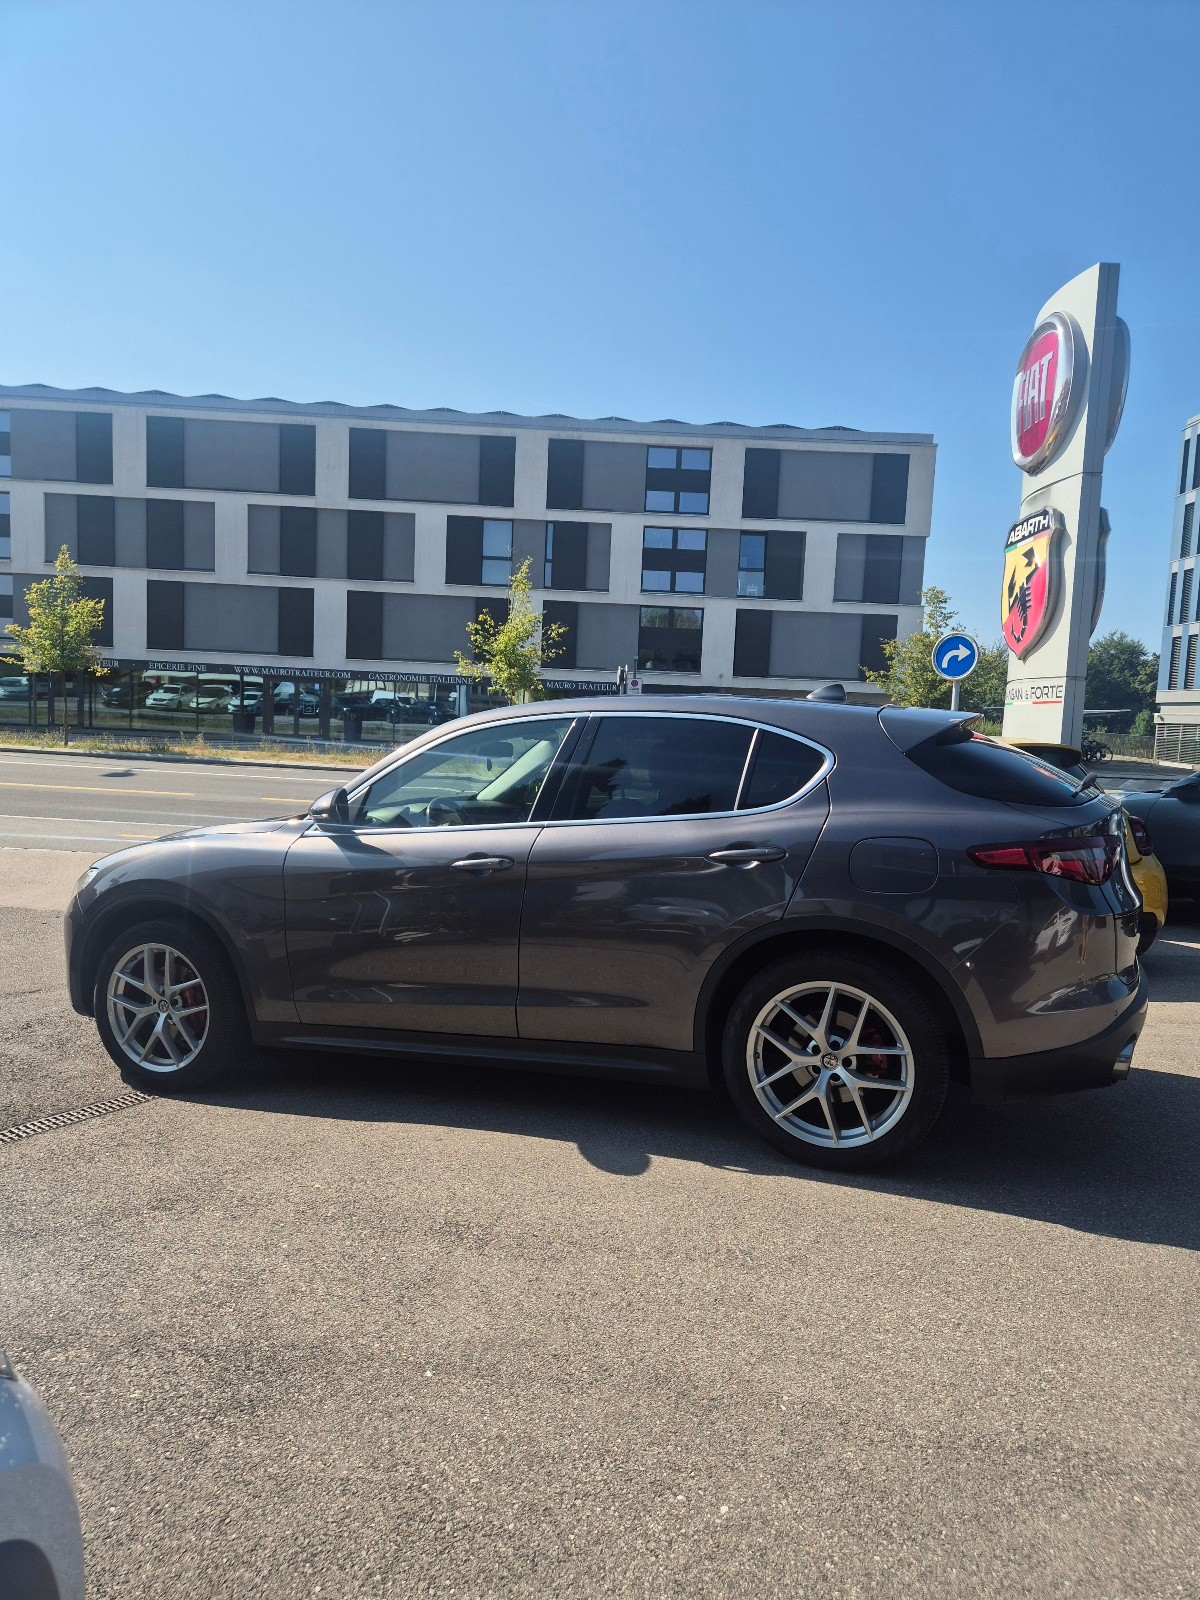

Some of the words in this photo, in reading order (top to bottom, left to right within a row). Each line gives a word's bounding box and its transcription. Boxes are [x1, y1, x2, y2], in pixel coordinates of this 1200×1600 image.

[1017, 351, 1054, 437] FIAT
[1007, 515, 1049, 545] ABARTH
[148, 662, 186, 671] EPICERIE
[187, 663, 207, 672] FINE
[368, 672, 428, 683] GASTRONOMIE
[429, 675, 474, 685] ITALIENNE
[546, 681, 576, 690] MAURO
[577, 682, 617, 691] TRAITEUR
[1030, 685, 1063, 700] FORTE
